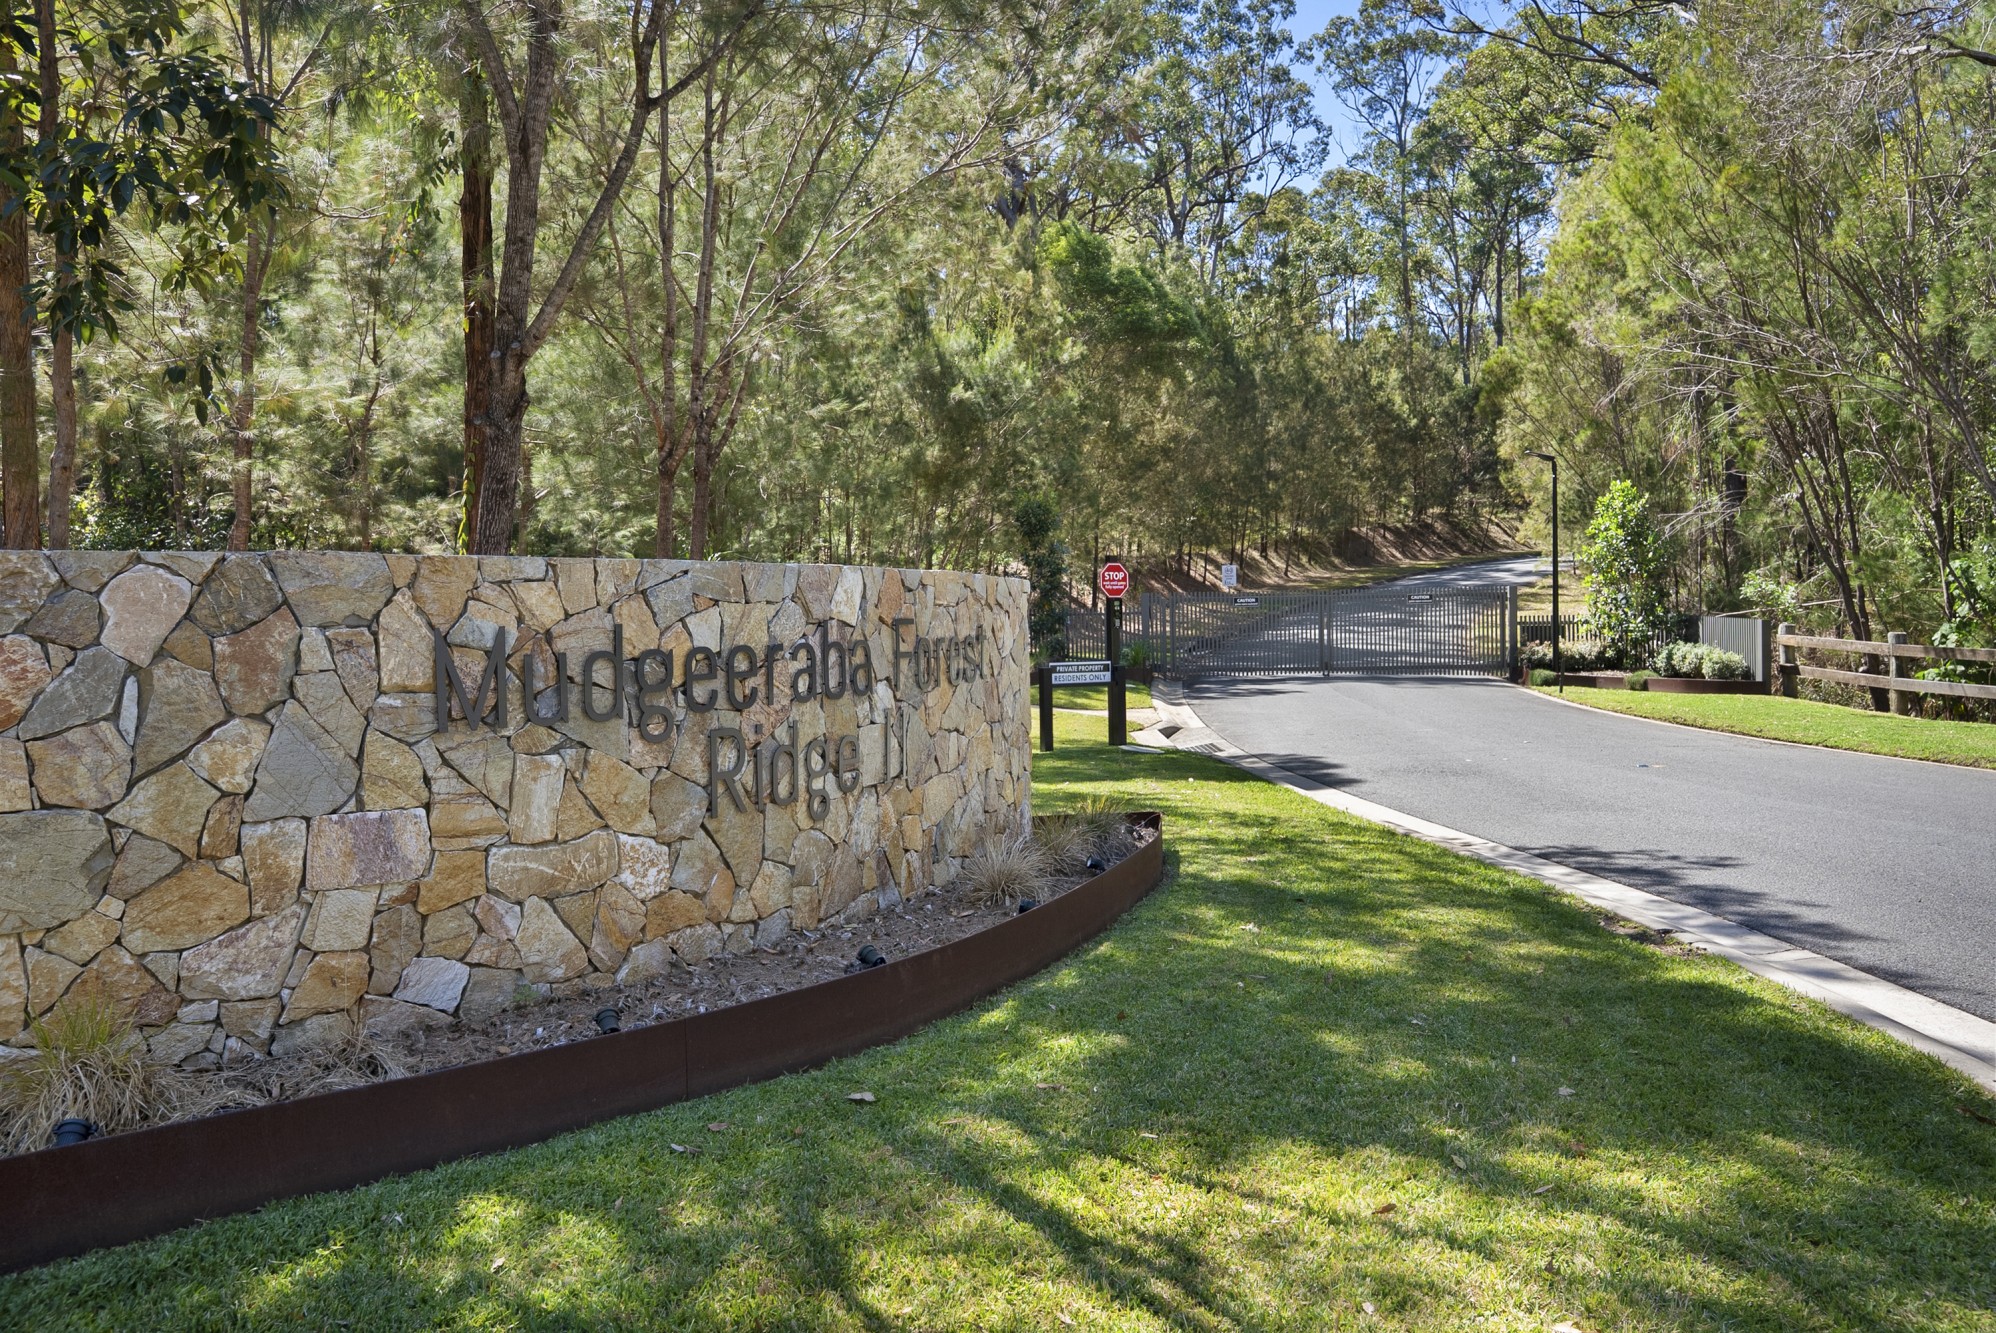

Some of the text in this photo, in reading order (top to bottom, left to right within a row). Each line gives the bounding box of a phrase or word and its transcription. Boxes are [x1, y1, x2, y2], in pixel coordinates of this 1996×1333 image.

[1104, 571, 1125, 580] STOP
[434, 617, 988, 743] Mudgeeraba Forest
[1053, 673, 1107, 682] RESIDENTS ONLY
[709, 719, 860, 822] Ridge
